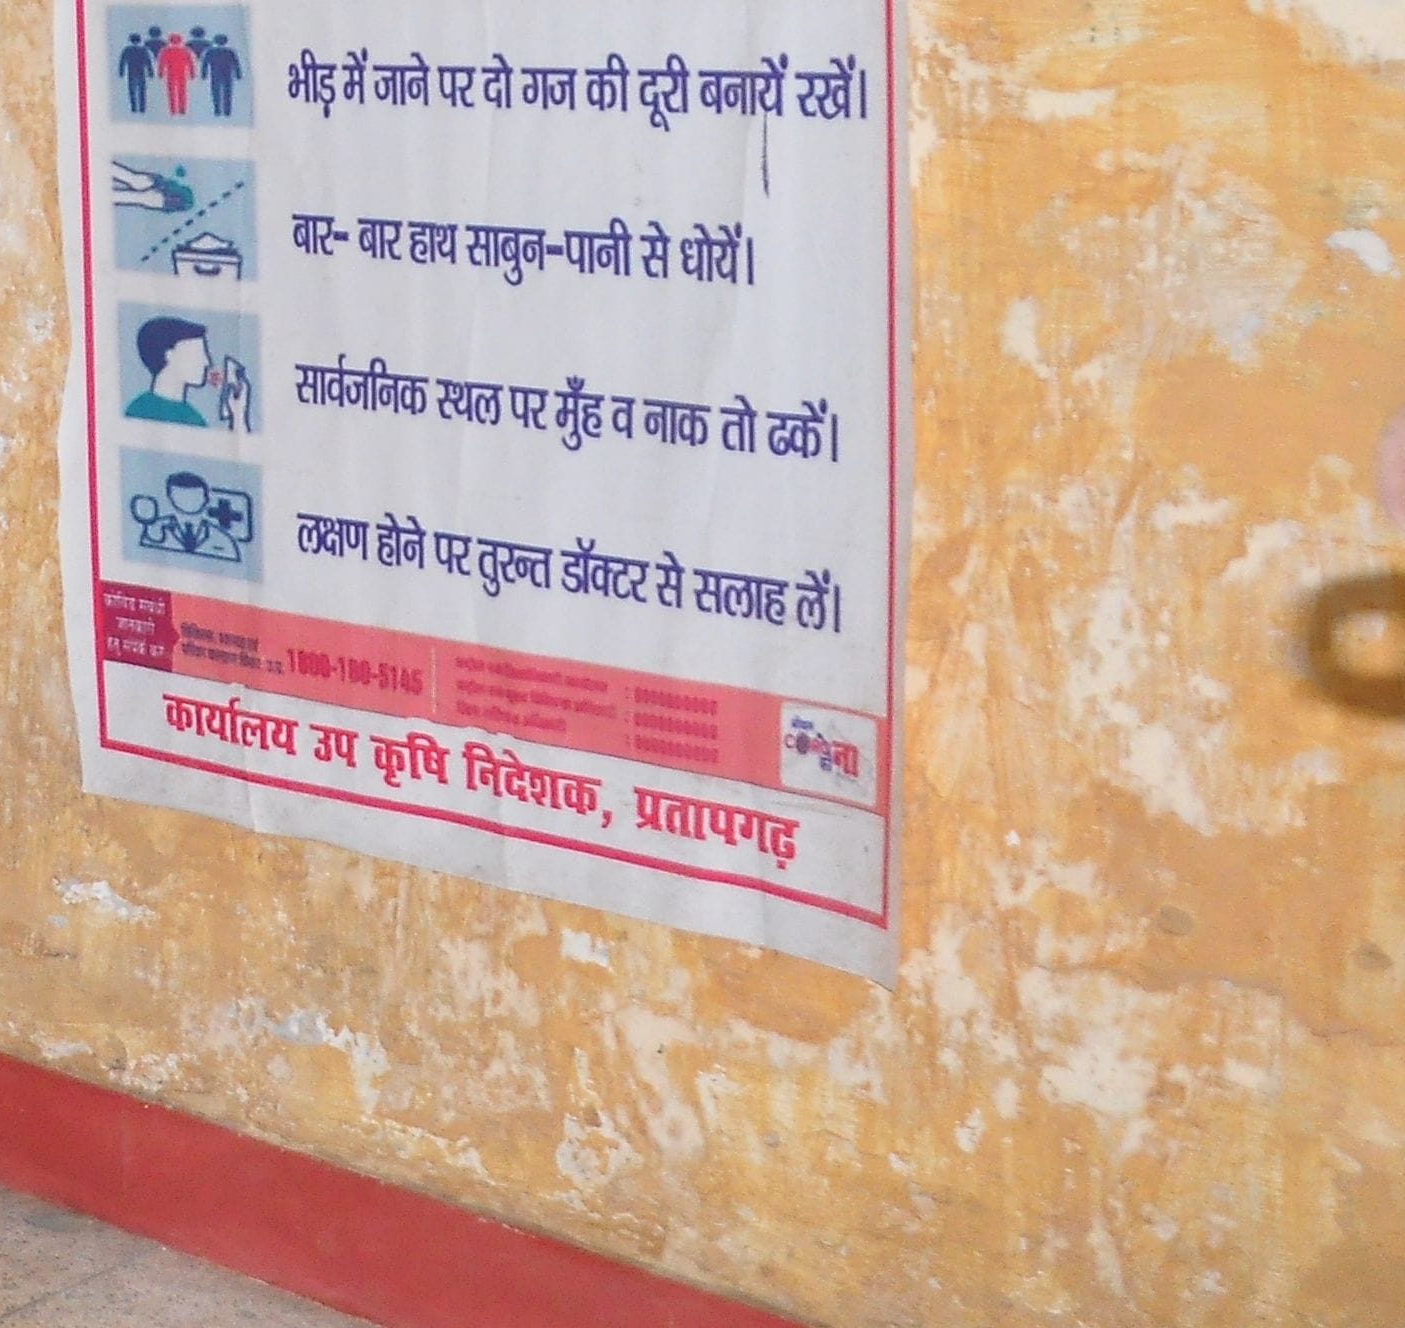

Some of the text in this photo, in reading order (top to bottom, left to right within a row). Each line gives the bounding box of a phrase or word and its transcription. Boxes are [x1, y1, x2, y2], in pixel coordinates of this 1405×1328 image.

[288, 48, 337, 119] भीड़
[342, 46, 371, 110] में
[374, 56, 431, 111] जाने
[437, 75, 476, 111] पर
[483, 58, 515, 118] दो
[522, 74, 576, 113] गज
[585, 58, 629, 113] की
[637, 58, 689, 131] दूरी
[699, 51, 788, 118] बनायें
[358, 218, 403, 261] बार
[408, 220, 459, 266] हाथ
[641, 220, 670, 279] से
[294, 353, 429, 412] सार्वजनिक
[436, 386, 502, 426] स्थल
[509, 394, 550, 431] पर
[556, 374, 605, 449] मुँह
[611, 402, 636, 441] व
[642, 407, 710, 449] नाक
[722, 397, 756, 454] तो
[296, 513, 369, 563] लक्षण
[374, 511, 428, 566] होने
[434, 537, 472, 579] पर
[476, 543, 553, 600] तुरन्त
[561, 535, 649, 605] डॉक्टर
[655, 552, 684, 610] से
[694, 571, 788, 620] सलाह
[164, 688, 294, 756] कार्यालय
[311, 720, 358, 769] उप
[372, 729, 449, 789] कृषि
[462, 742, 613, 828] निदेशक,
[634, 785, 800, 870] प्रतापगढ़
